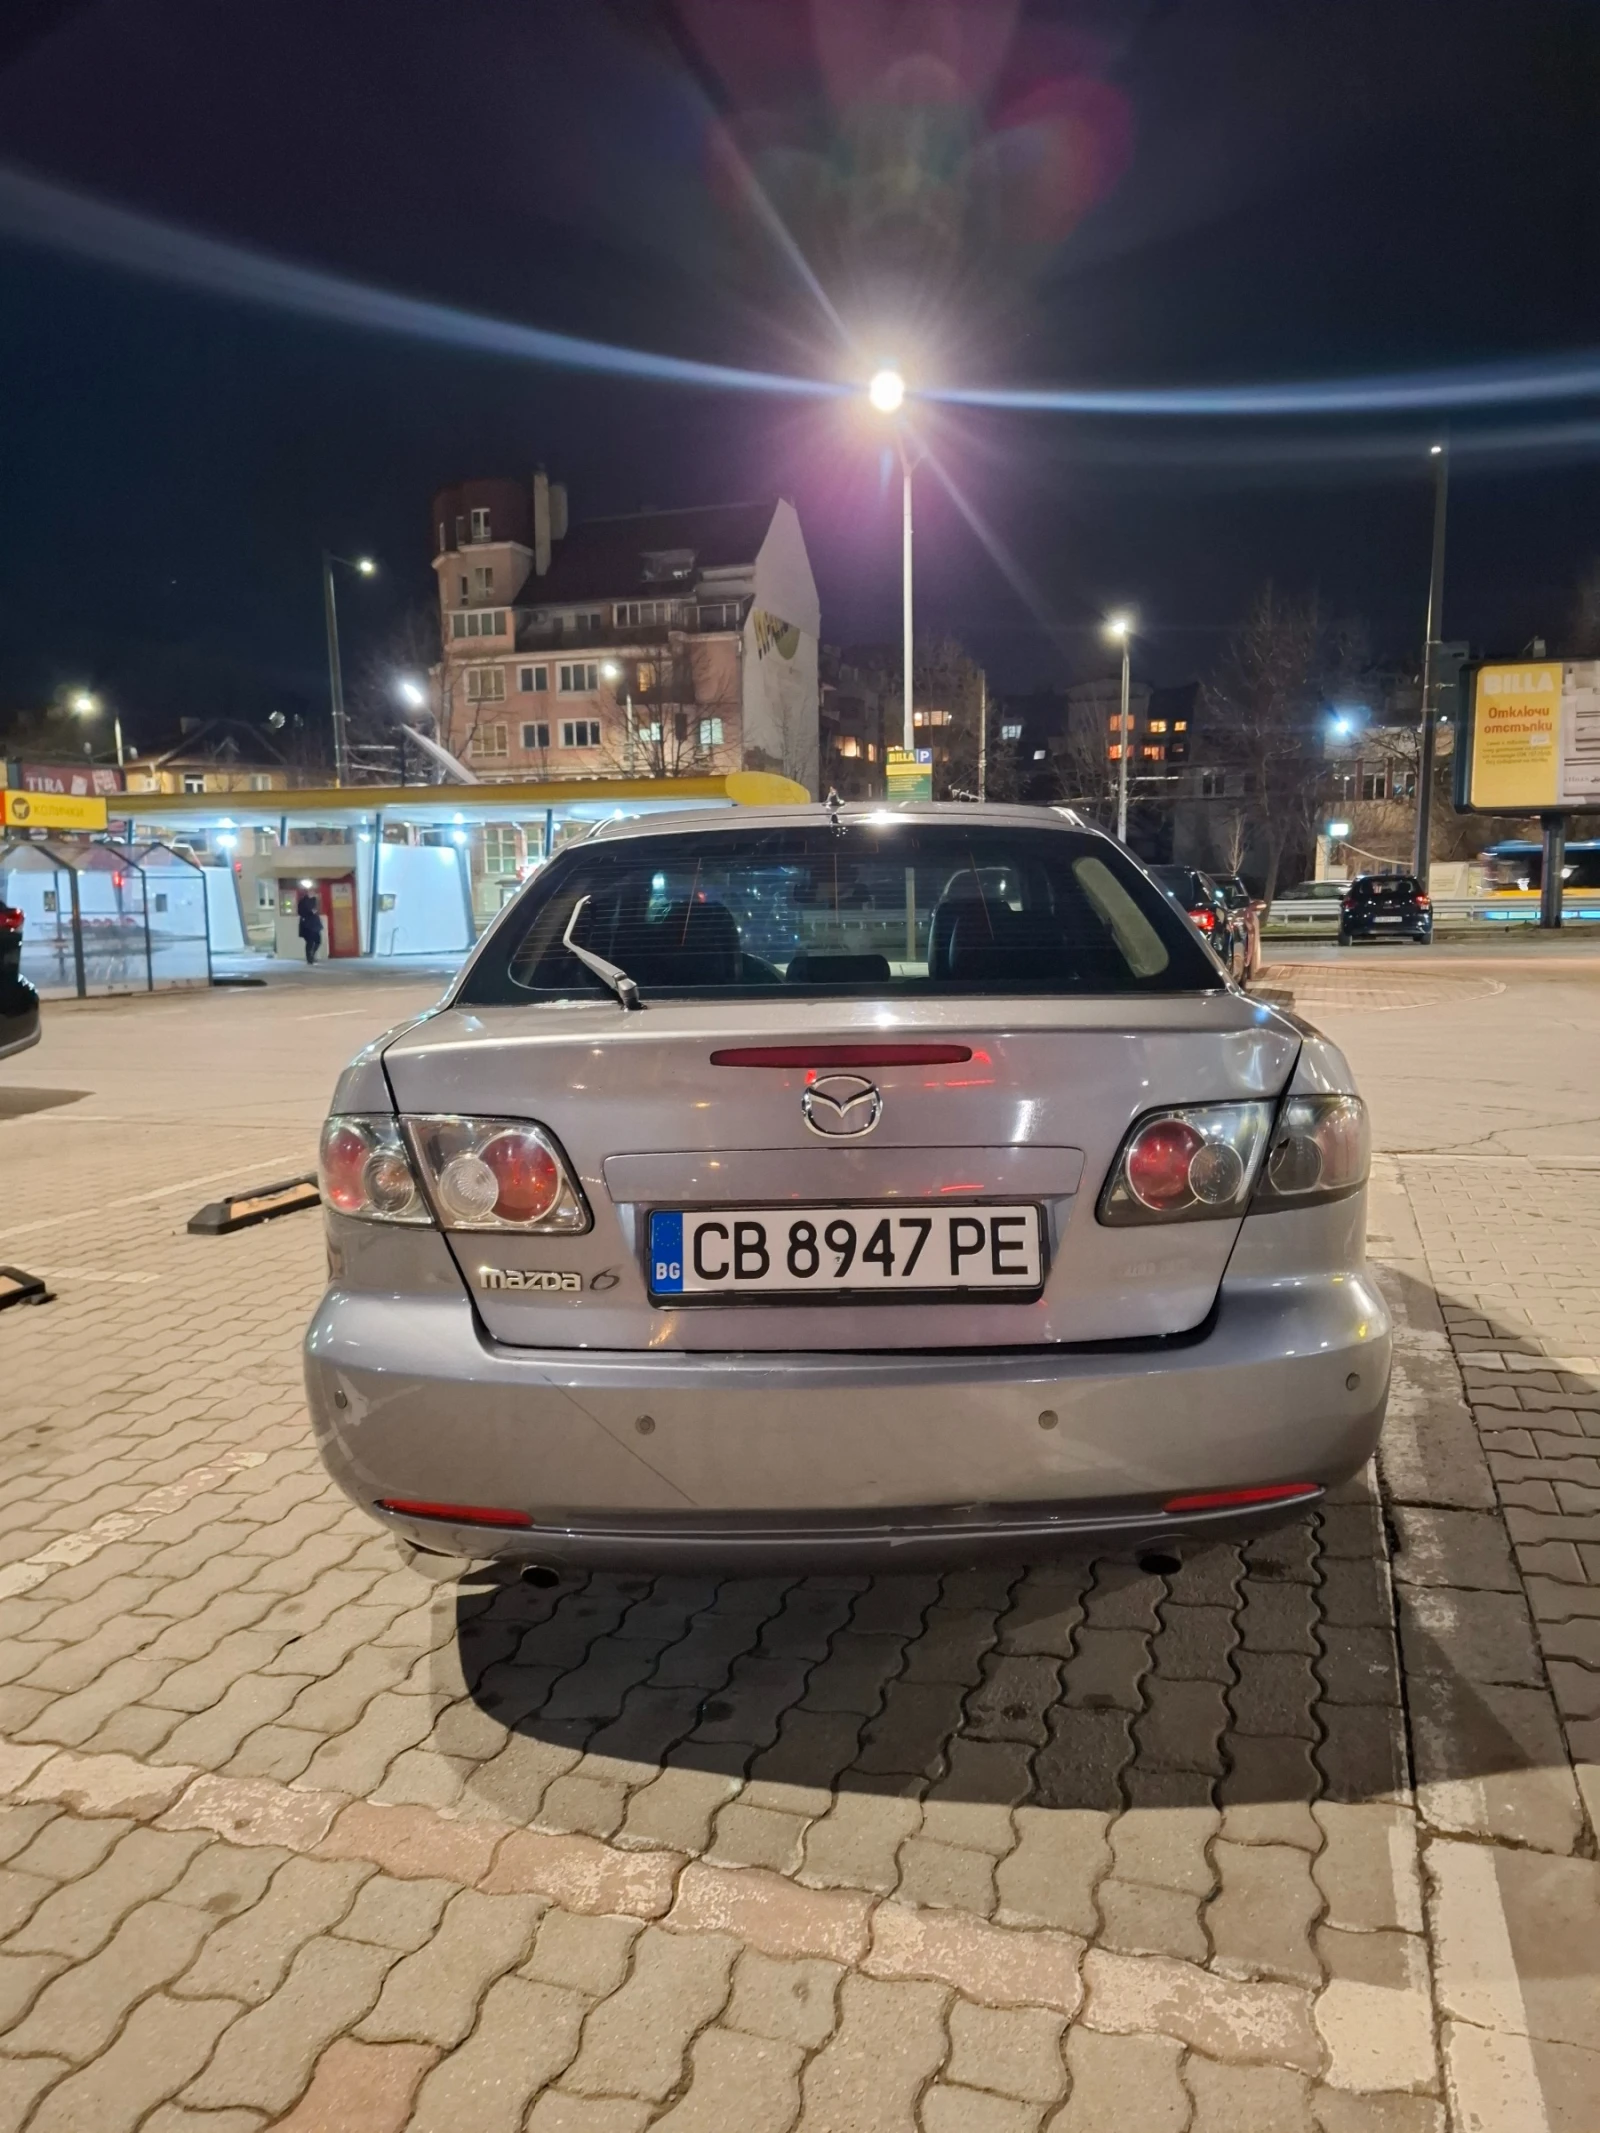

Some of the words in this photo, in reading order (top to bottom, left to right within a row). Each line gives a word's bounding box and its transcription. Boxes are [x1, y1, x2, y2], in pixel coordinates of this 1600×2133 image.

[1484, 672, 1554, 695] BILLA
[1488, 706, 1550, 719] Отключи
[1484, 720, 1553, 734] отстъпки
[888, 752, 915, 763] BILLA
[920, 751, 930, 762] P
[693, 1221, 770, 1280] CB
[787, 1217, 932, 1279] 8947
[949, 1217, 1029, 1276] PE
[590, 1267, 621, 1291] 6
[656, 1262, 680, 1280] BG
